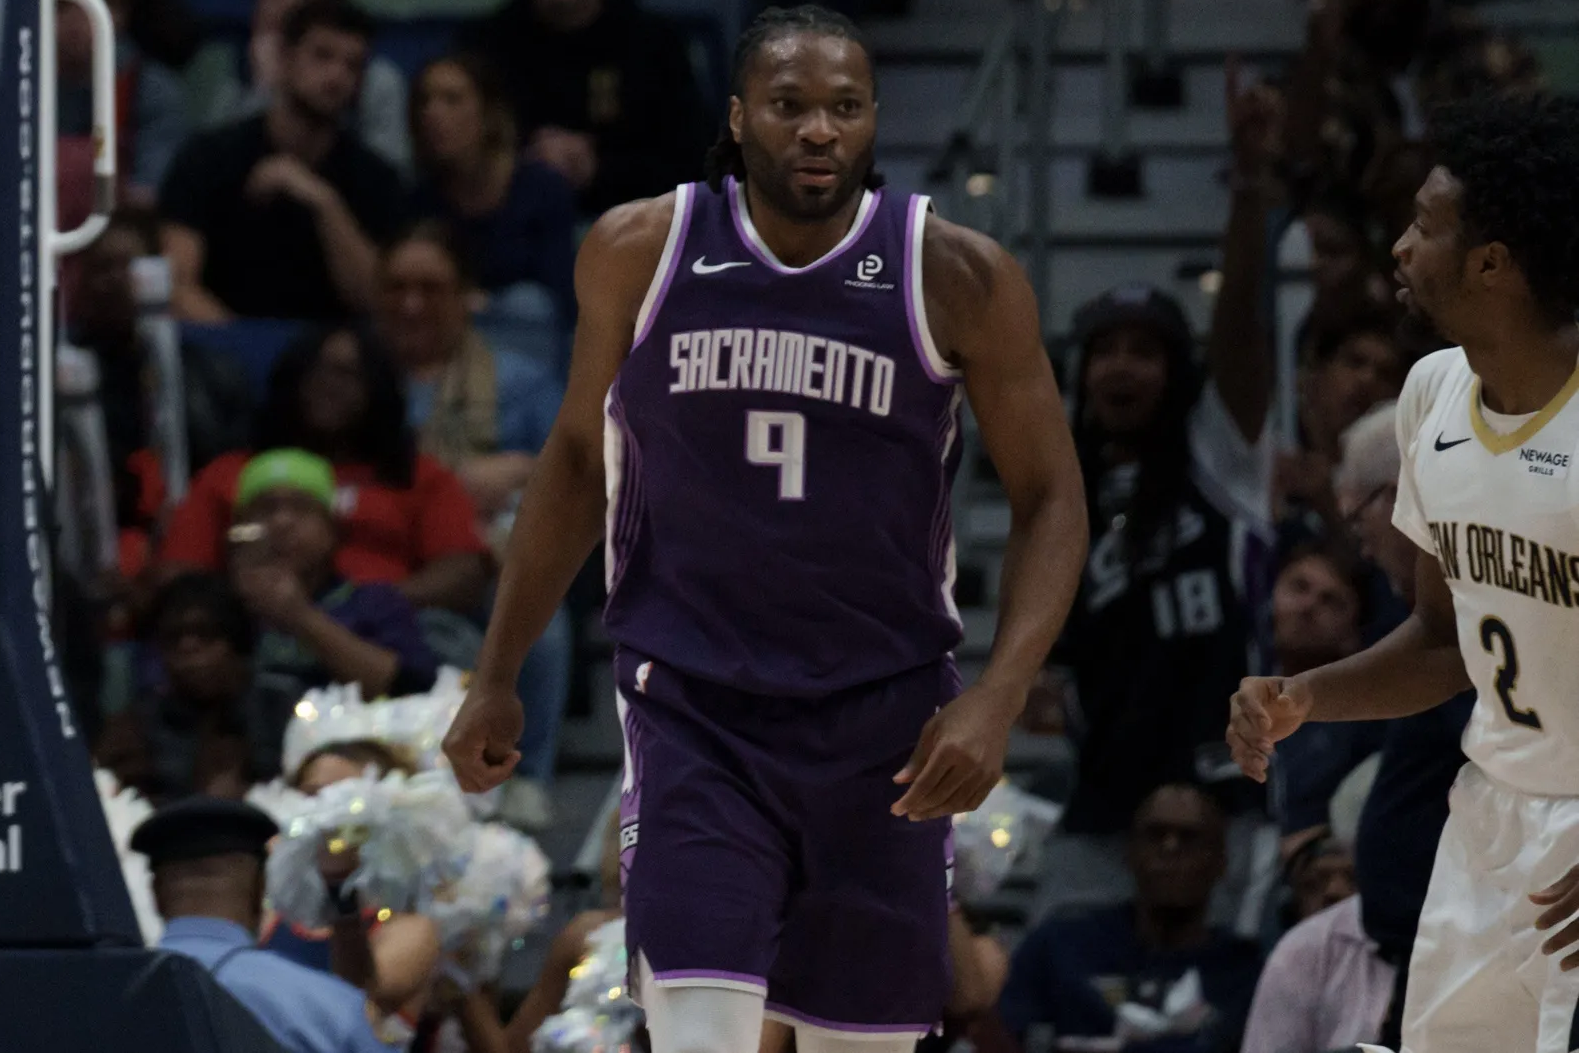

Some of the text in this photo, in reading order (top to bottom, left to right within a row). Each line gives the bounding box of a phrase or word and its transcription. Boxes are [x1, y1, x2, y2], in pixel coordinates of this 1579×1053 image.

[669, 327, 896, 418] SACRAMENTO
[744, 409, 807, 502] 9
[1519, 447, 1570, 468] NEWAGE
[1149, 567, 1225, 640] 18
[1479, 613, 1545, 733] 2
